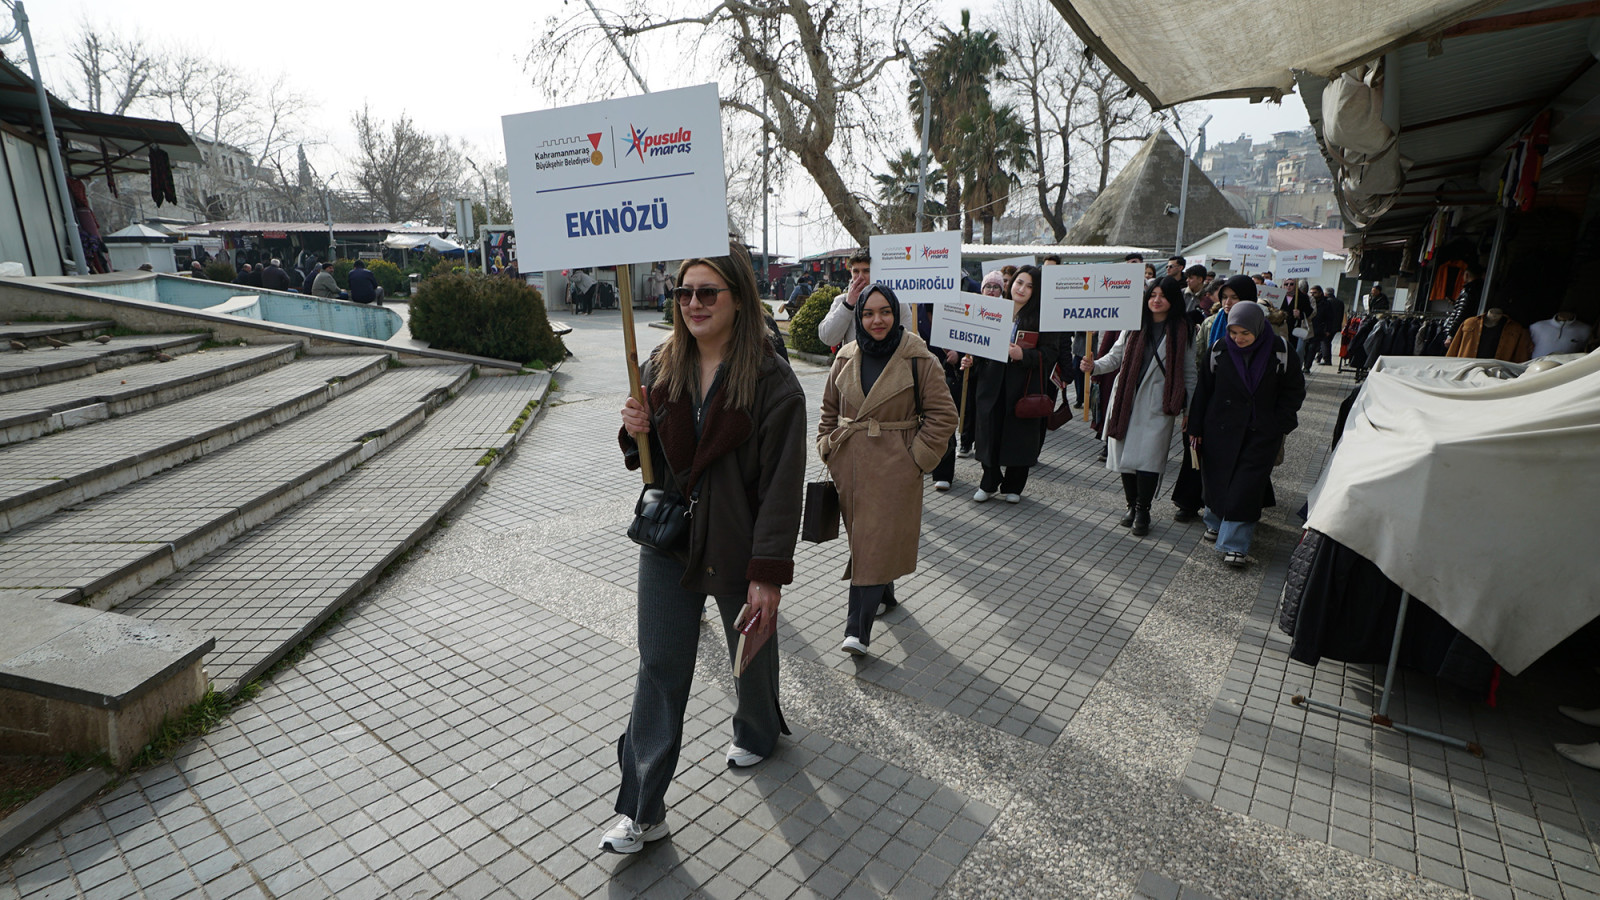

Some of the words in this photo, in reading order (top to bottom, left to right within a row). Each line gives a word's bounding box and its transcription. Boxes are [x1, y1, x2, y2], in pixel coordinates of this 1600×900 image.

[643, 127, 692, 153] pusula
[534, 147, 590, 160] Kahramanmaraş
[650, 142, 692, 157] maraş
[535, 159, 564, 171] Büyükşehir
[564, 156, 591, 167] Belediyesi
[928, 247, 949, 257] pusula
[1287, 266, 1310, 274] GÖKSUN
[1108, 278, 1132, 288] pusula
[1063, 307, 1119, 319] PAZARCIK
